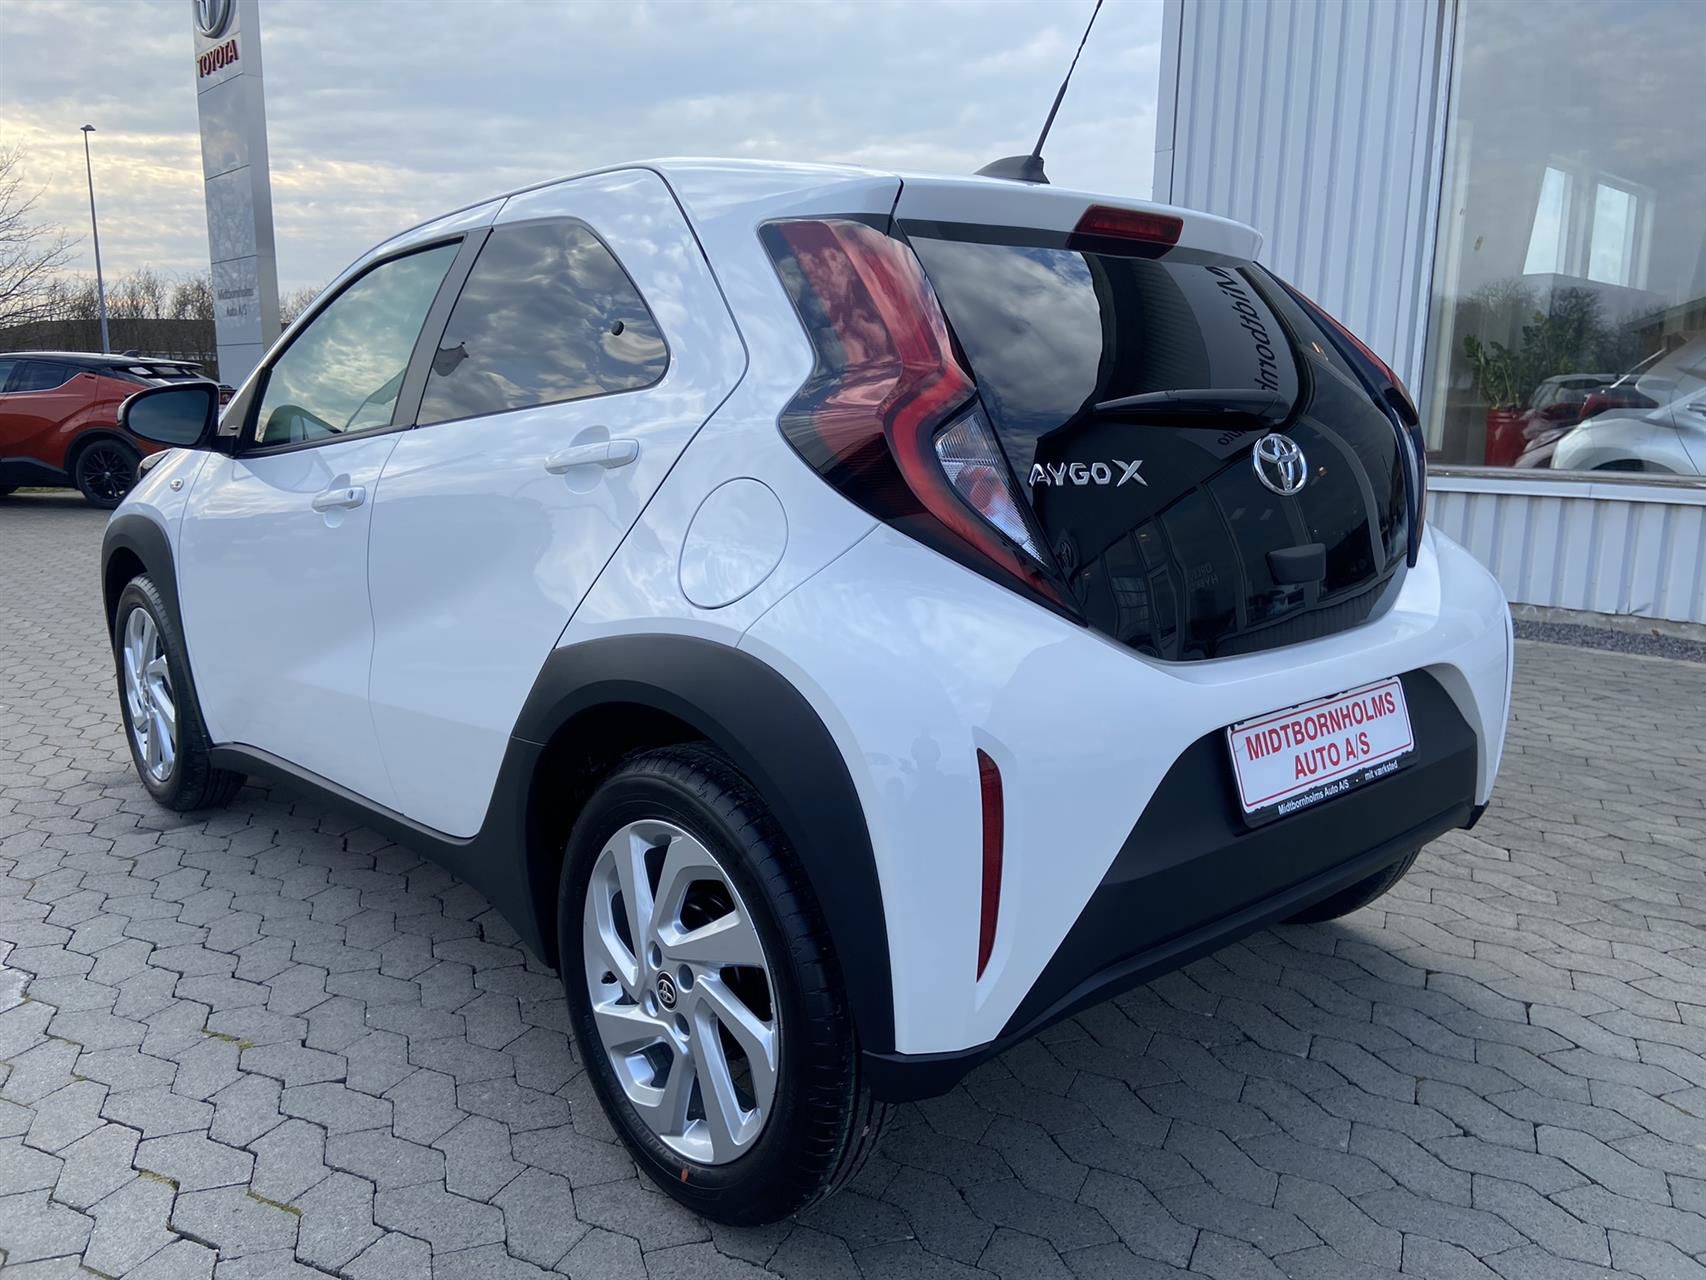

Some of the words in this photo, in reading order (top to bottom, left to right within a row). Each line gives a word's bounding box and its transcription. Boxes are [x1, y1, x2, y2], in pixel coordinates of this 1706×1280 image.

[197, 39, 239, 78] TOYOTA
[1028, 462, 1112, 487] AYGO
[1112, 459, 1149, 487] X
[1245, 691, 1396, 760] MIDTBORNHOLMS
[1295, 742, 1341, 779] AUTO
[1345, 732, 1370, 761] A/S
[1278, 790, 1324, 815] Midtbornholms
[1324, 785, 1339, 797] Auto
[1339, 779, 1350, 792] A/S
[1364, 770, 1375, 781] mit
